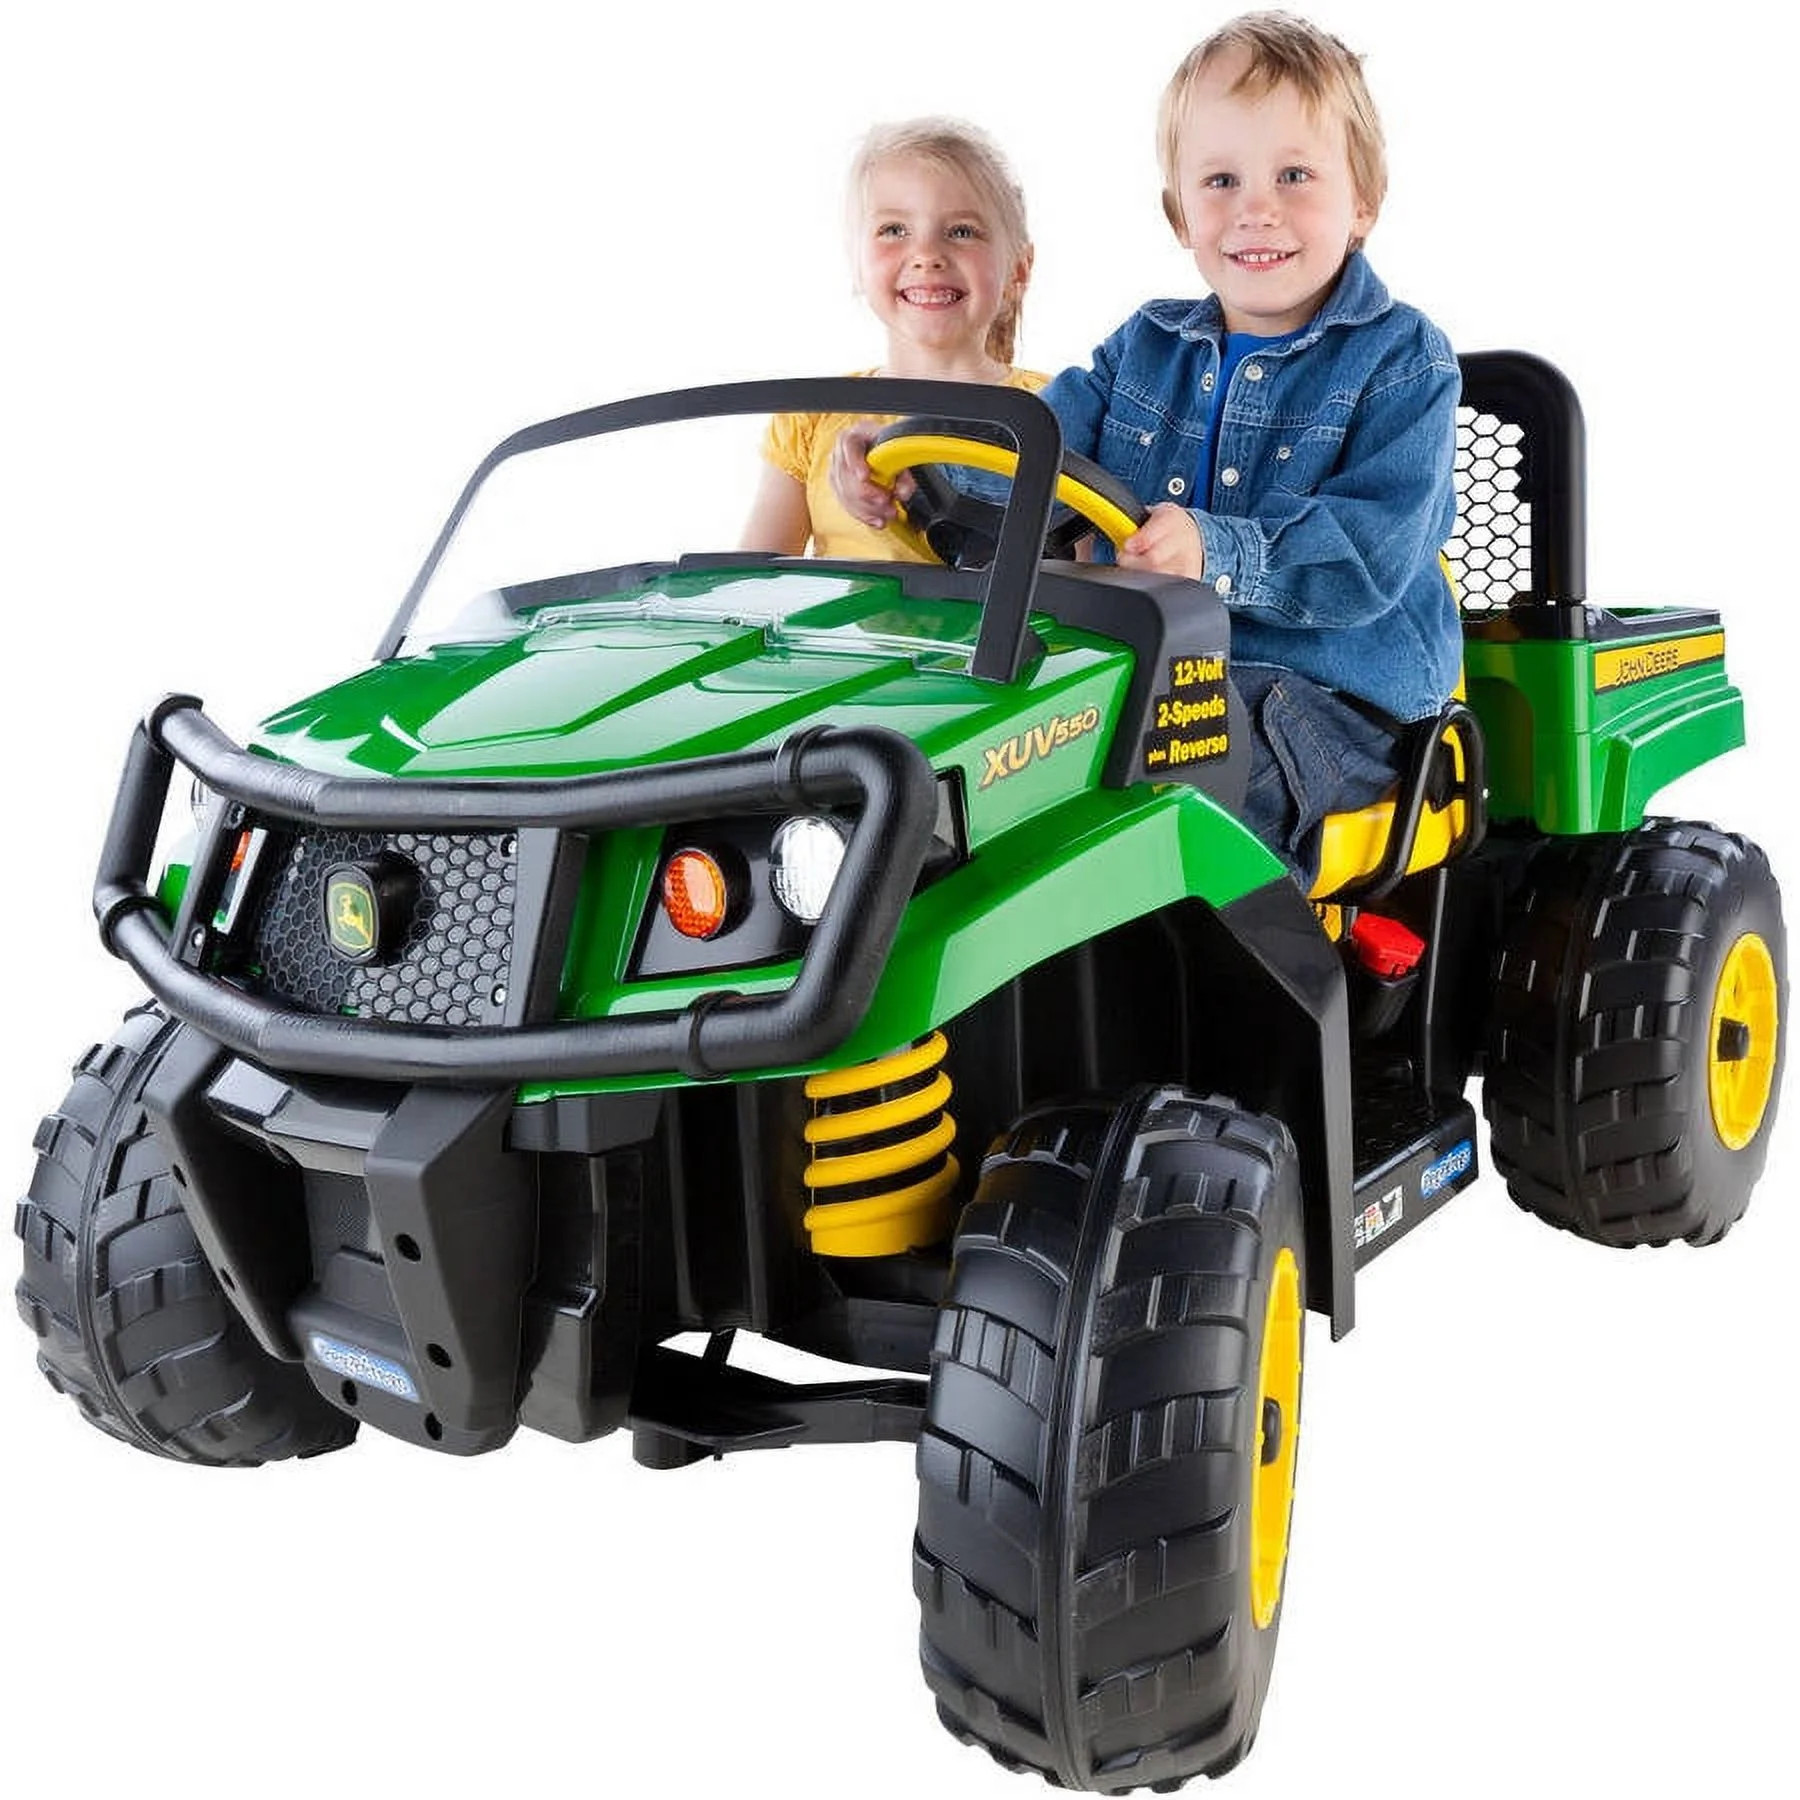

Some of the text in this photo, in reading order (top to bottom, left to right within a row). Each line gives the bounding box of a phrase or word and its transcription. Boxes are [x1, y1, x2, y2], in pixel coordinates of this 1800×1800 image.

[1174, 658, 1224, 686] 12-Volt
[1157, 694, 1226, 728] 2-Speeds
[1169, 734, 1228, 764] Reverse
